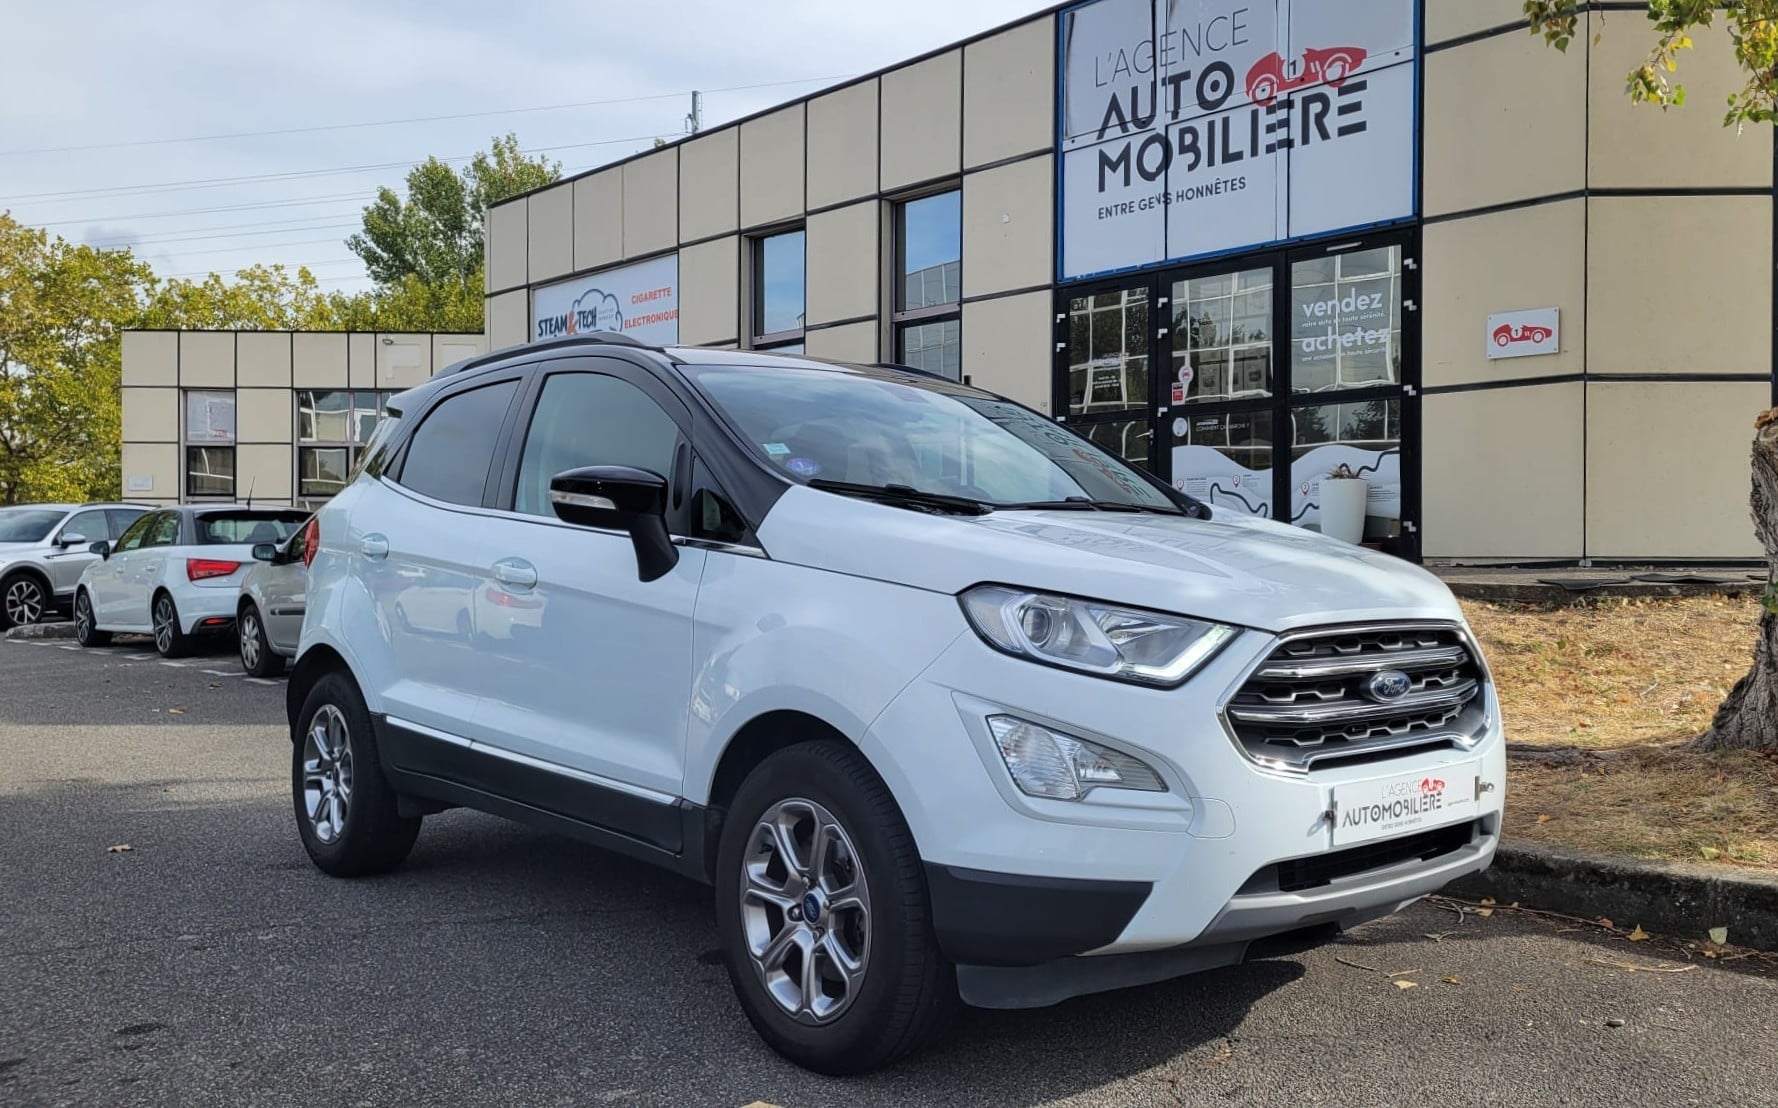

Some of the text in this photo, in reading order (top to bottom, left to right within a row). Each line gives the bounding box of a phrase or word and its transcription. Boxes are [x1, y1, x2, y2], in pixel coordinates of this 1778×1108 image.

[1095, 8, 1249, 88] L'AGENCE
[1096, 60, 1235, 141] AUTO
[1098, 176, 1247, 220] ENTRE GENS HONNÊTES
[631, 286, 673, 305] CIGARETTE
[1302, 287, 1383, 318] vendez
[623, 309, 679, 329] ELECTRONIQUE
[1302, 326, 1391, 352] achetez
